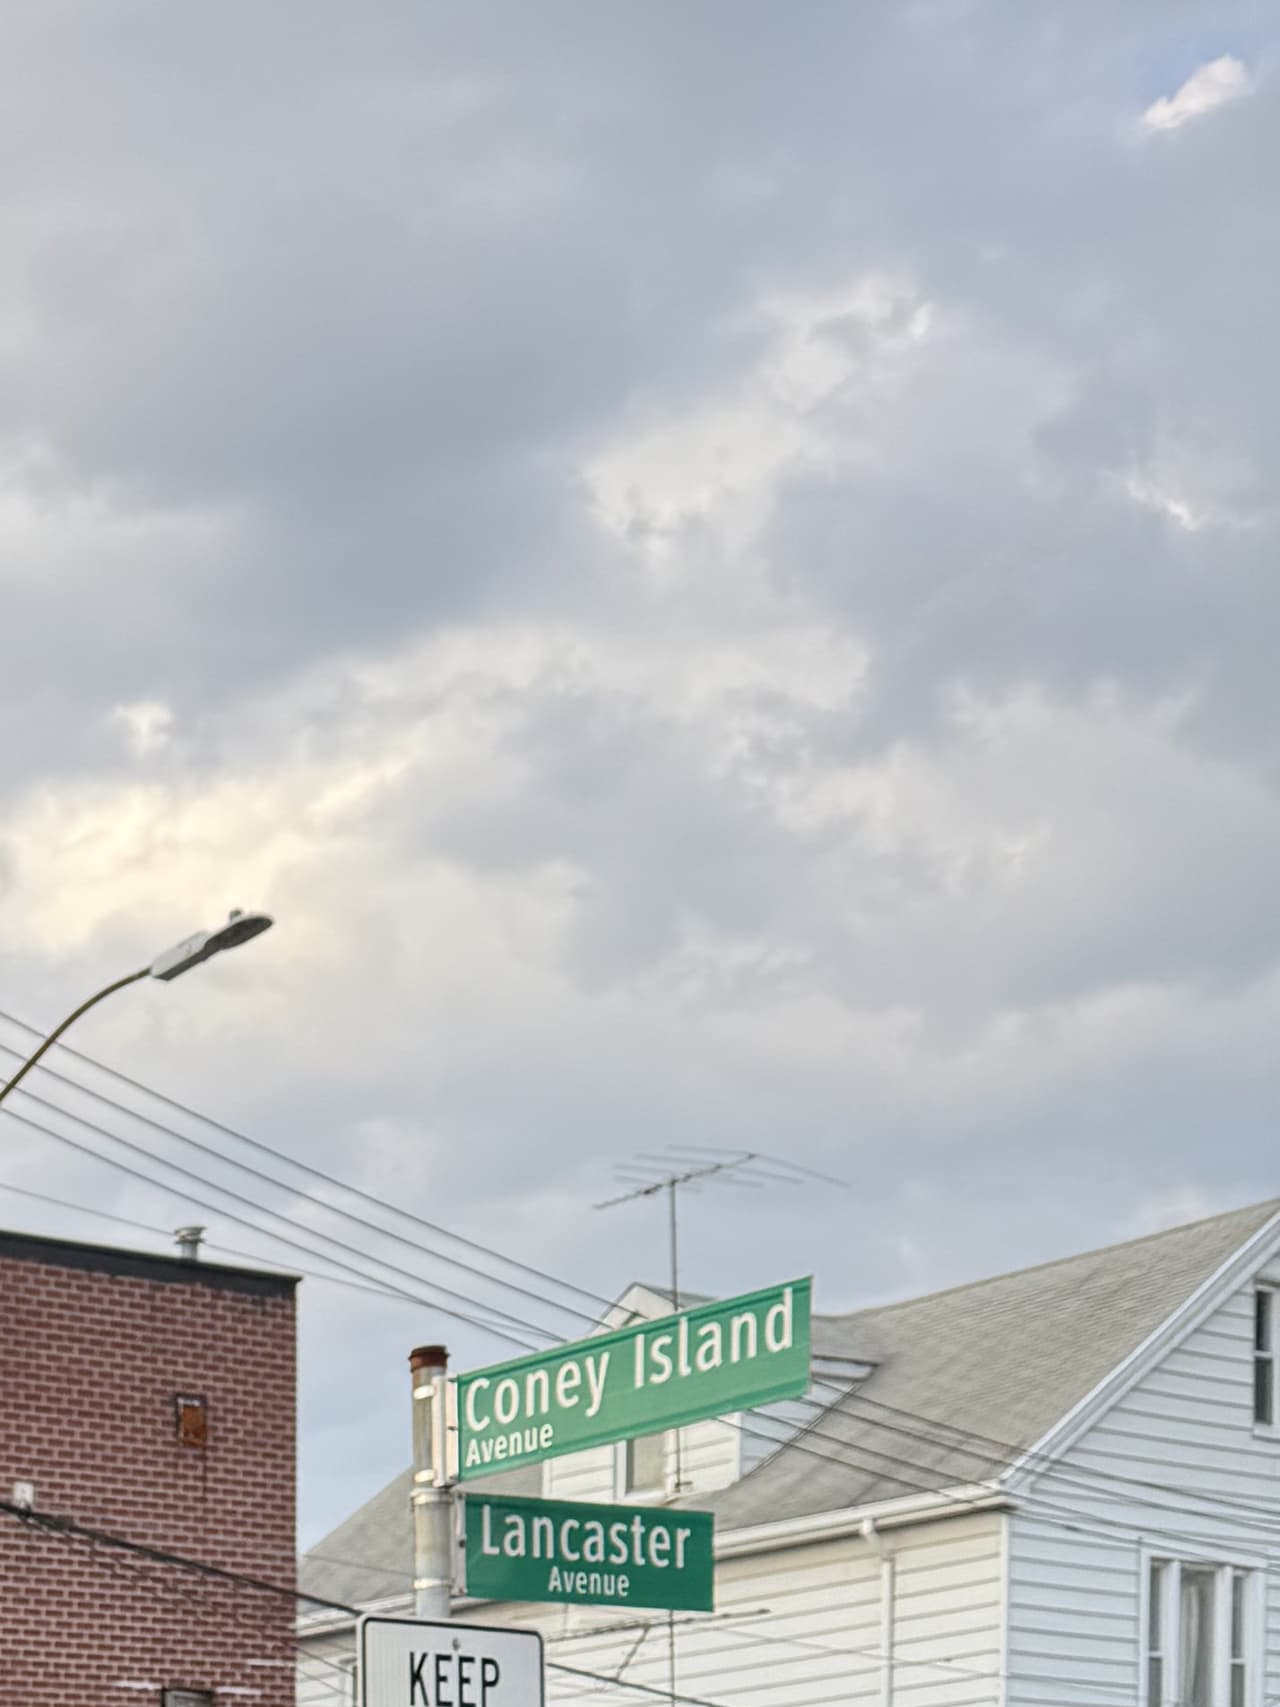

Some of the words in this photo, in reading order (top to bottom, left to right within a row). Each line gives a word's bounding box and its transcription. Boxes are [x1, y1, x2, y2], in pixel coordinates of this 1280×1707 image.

[464, 1350, 610, 1431] Coney
[633, 1286, 794, 1388] Island
[465, 1419, 554, 1468] Avenue
[481, 1504, 692, 1569] Lancaster
[547, 1566, 630, 1598] Avenue
